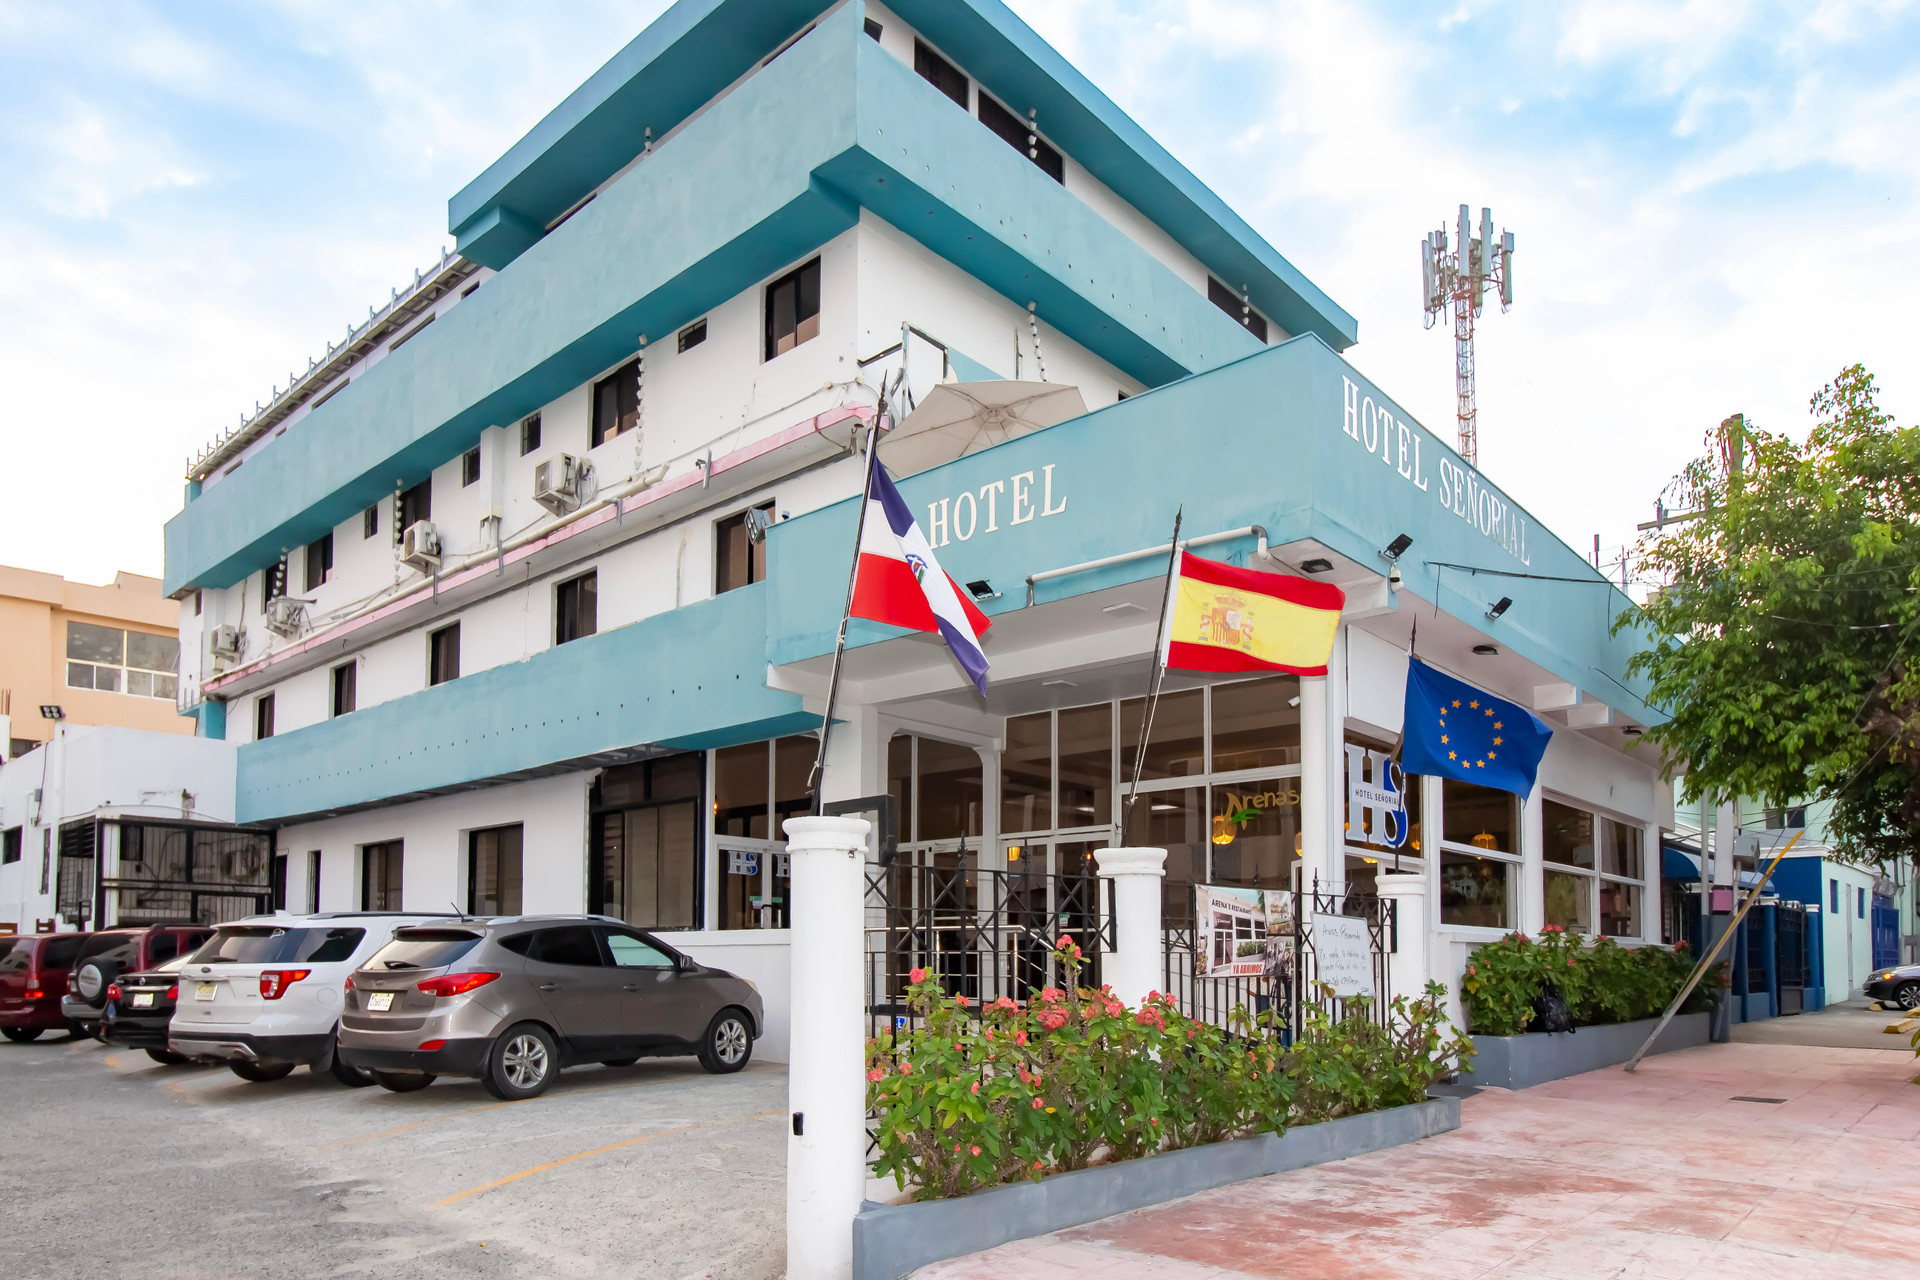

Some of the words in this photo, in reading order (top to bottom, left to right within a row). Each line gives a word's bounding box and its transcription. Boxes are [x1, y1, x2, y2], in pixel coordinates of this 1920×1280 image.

[1342, 375, 1428, 492] HOTEL
[1439, 457, 1531, 567] SEÑORIAL
[927, 463, 1067, 550] HOTEL
[1355, 788, 1373, 801] HOTEL
[1232, 964, 1240, 974] YA
[1240, 964, 1263, 974] ABRIMOS
